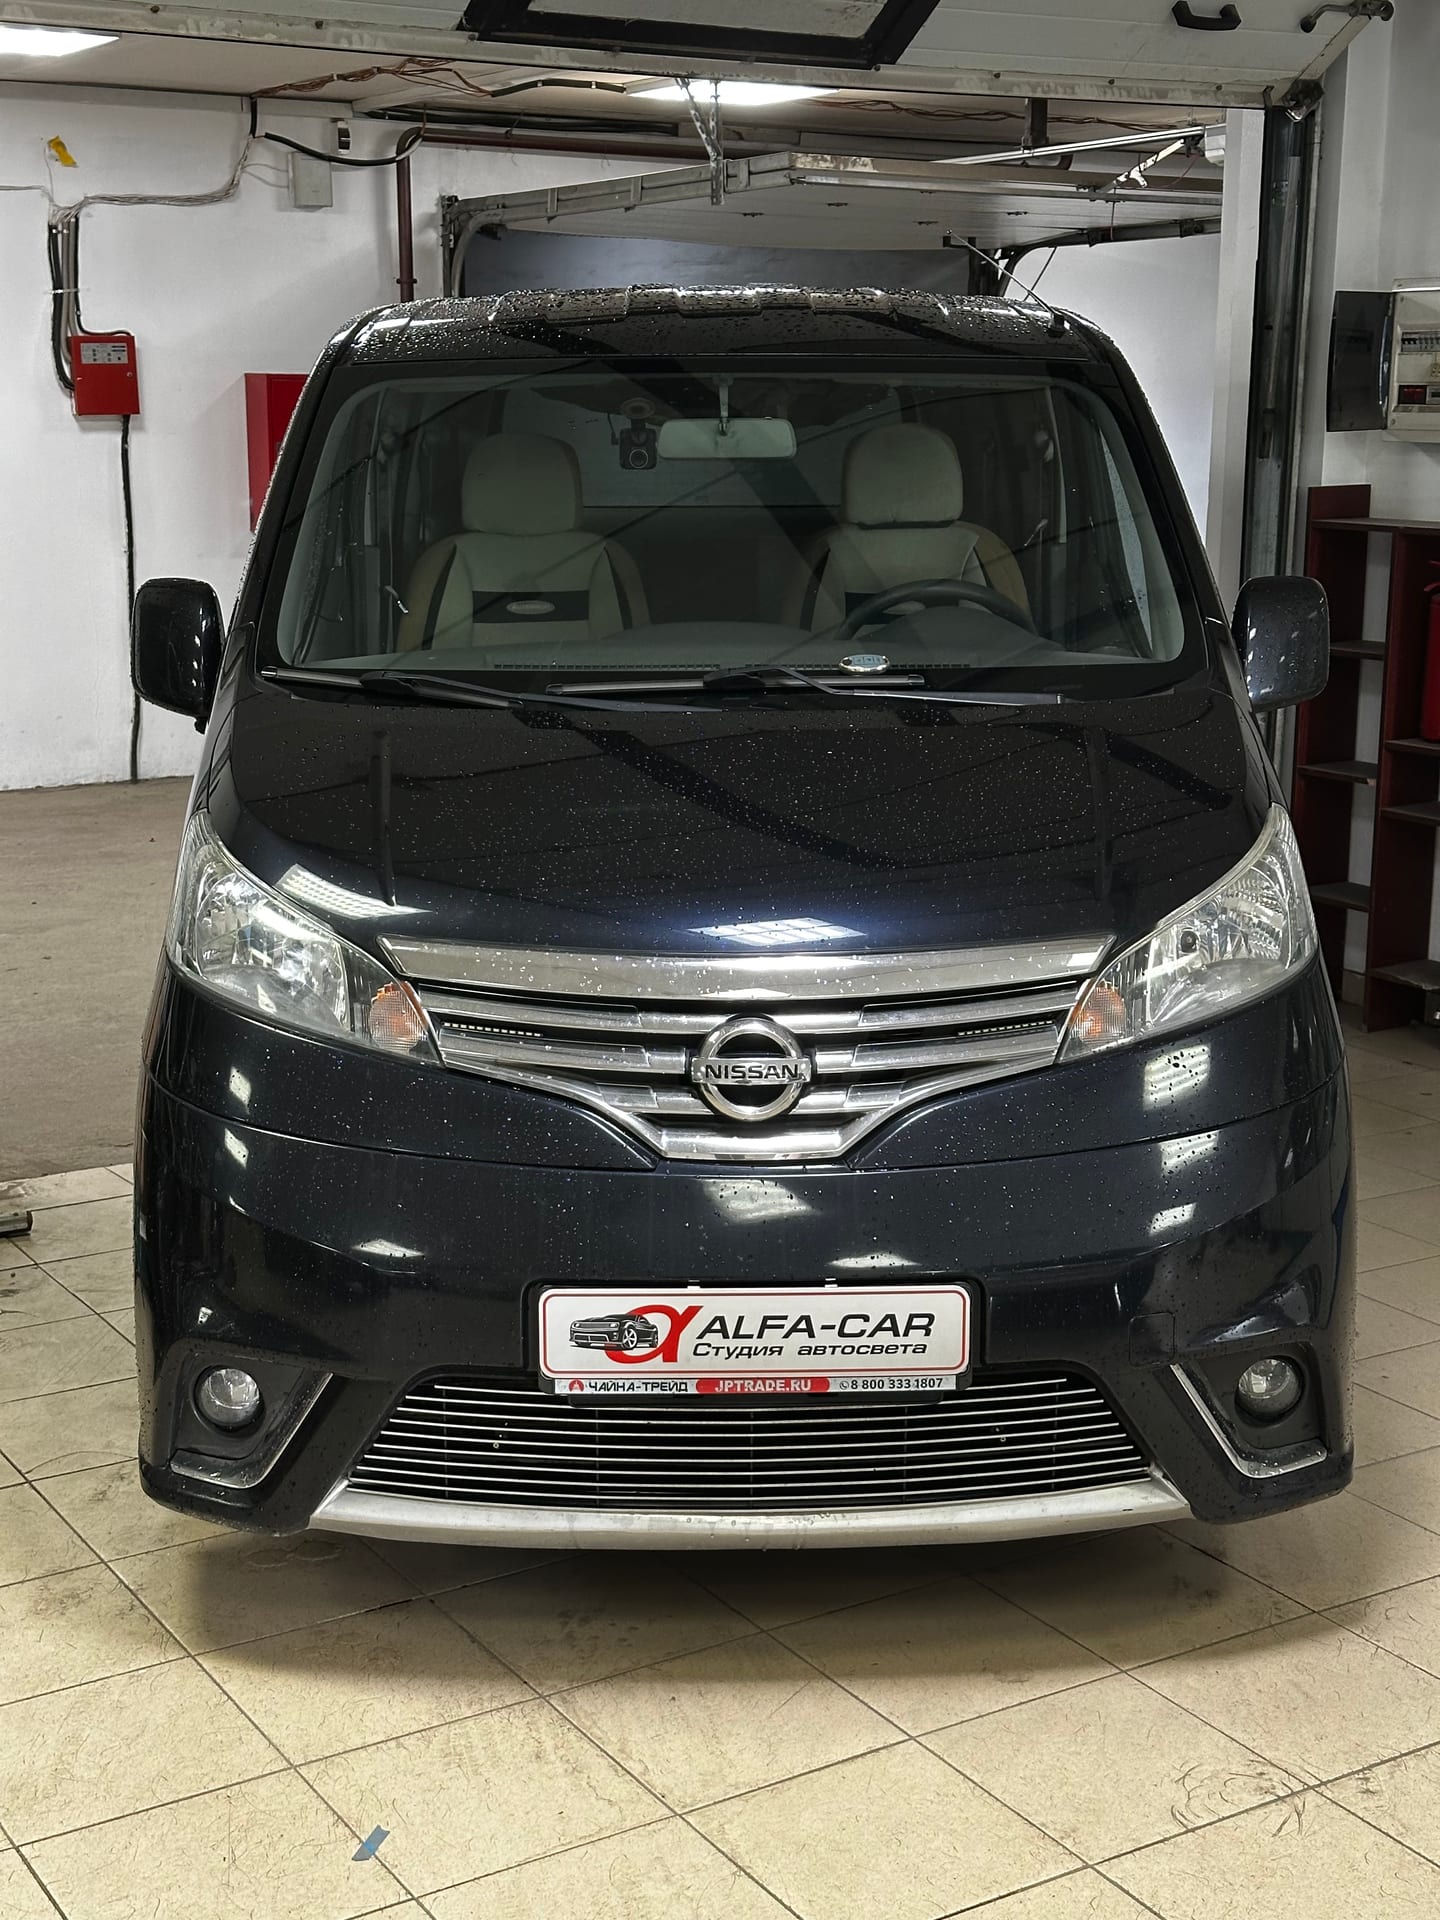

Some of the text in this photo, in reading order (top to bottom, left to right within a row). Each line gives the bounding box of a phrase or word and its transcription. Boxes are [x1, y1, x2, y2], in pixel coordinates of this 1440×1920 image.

[705, 1063, 799, 1080] NISSAN
[696, 1312, 936, 1340] ALFA-CAR
[693, 1342, 928, 1360] Студия автосвета
[588, 1380, 689, 1393] ЧАЙНА-ТРЕЙД
[715, 1378, 812, 1392] JPTRADE.RU
[850, 1377, 943, 1390] 8 800 333 1807
